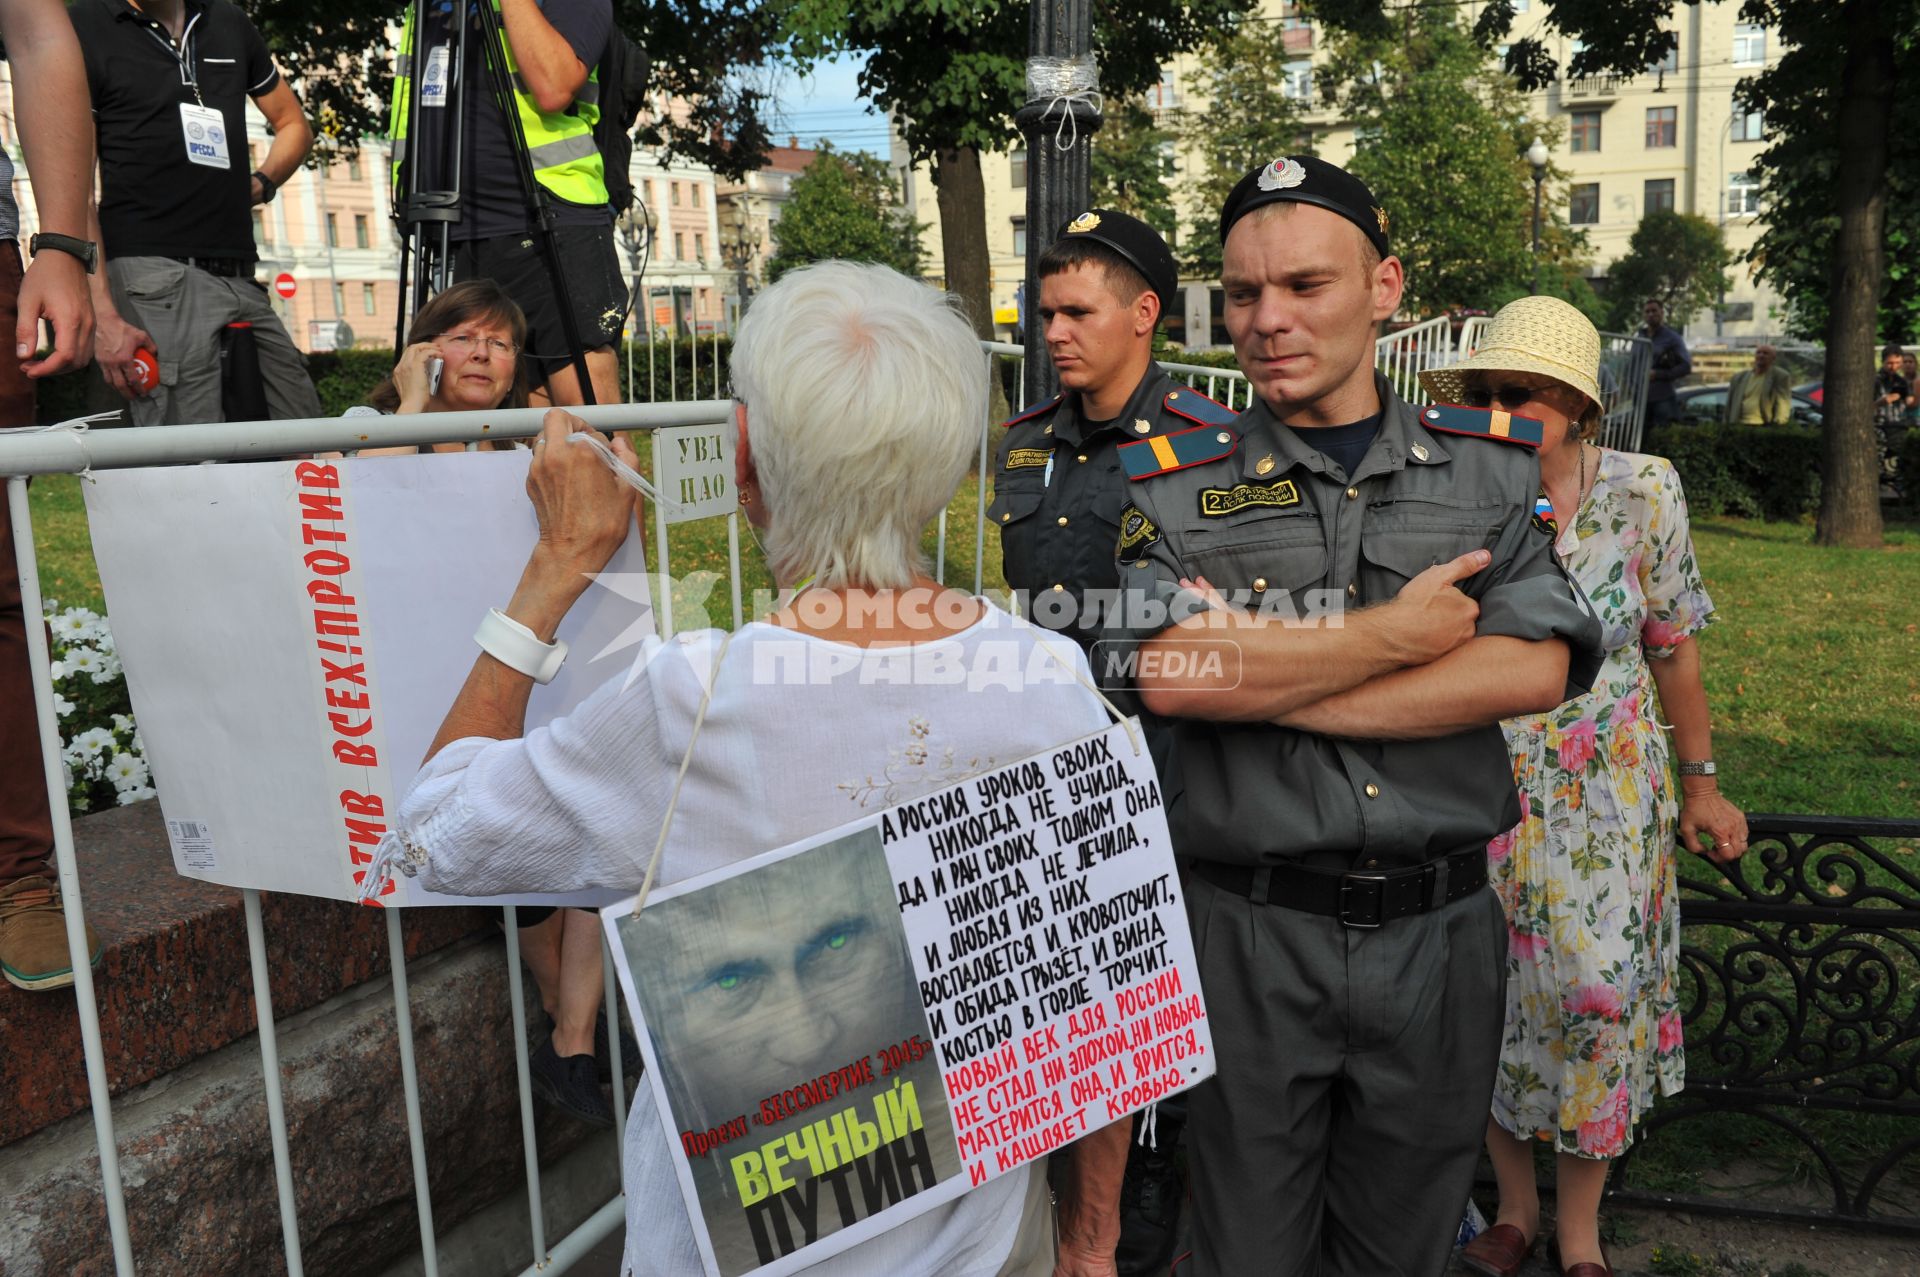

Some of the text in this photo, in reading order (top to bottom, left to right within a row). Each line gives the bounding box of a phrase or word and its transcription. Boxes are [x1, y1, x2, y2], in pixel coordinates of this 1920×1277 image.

[677, 434, 723, 464] УВД
[680, 473, 724, 507] ЦАО
[1210, 494, 1221, 509] 2
[1223, 495, 1246, 509] ПОЛК
[882, 734, 1114, 845] А РОССИЯ УРОКОВ СВОИХ
[898, 780, 1161, 913] ДА И РАН СВОИХ ТОЛКОМ ОНА
[928, 760, 1135, 863] НИКОГДА НЕ УЧИЛА,
[924, 875, 1091, 973] И ЛЮБАЯ ИЗ НИХ
[945, 822, 1150, 926] НИКОГДА НЕ ЛЕЧИЛА,
[920, 874, 1175, 1008] ВОСПАЛЯЕТСЯ И КРОВОТОЧИТ,
[929, 912, 1165, 1040] И ОБИДА ГРЫЗЁТ, И ВИНА
[941, 940, 1173, 1067] КОСТЬЮ В ГОРЛЕ ТОРЧИТ.
[946, 967, 1182, 1099] НОВЫЙ ВЕК ДЛЯ РОССИИ
[955, 1100, 984, 1130] НЕ
[987, 1069, 1037, 1114] СТАЛ
[1042, 1057, 1066, 1088] НИ
[1154, 993, 1206, 1036] НОВЬЮ.
[681, 1115, 749, 1159] Проект
[730, 1076, 924, 1209] ВЕЧНЫЙ
[958, 1028, 1205, 1160] МАТЕРИТСЯ ОНА, И ЯРИТСЯ,
[969, 1068, 1185, 1187] И КАШЛЯЕТ КРОВЬЮ.
[744, 1127, 937, 1266] ПУТИН
